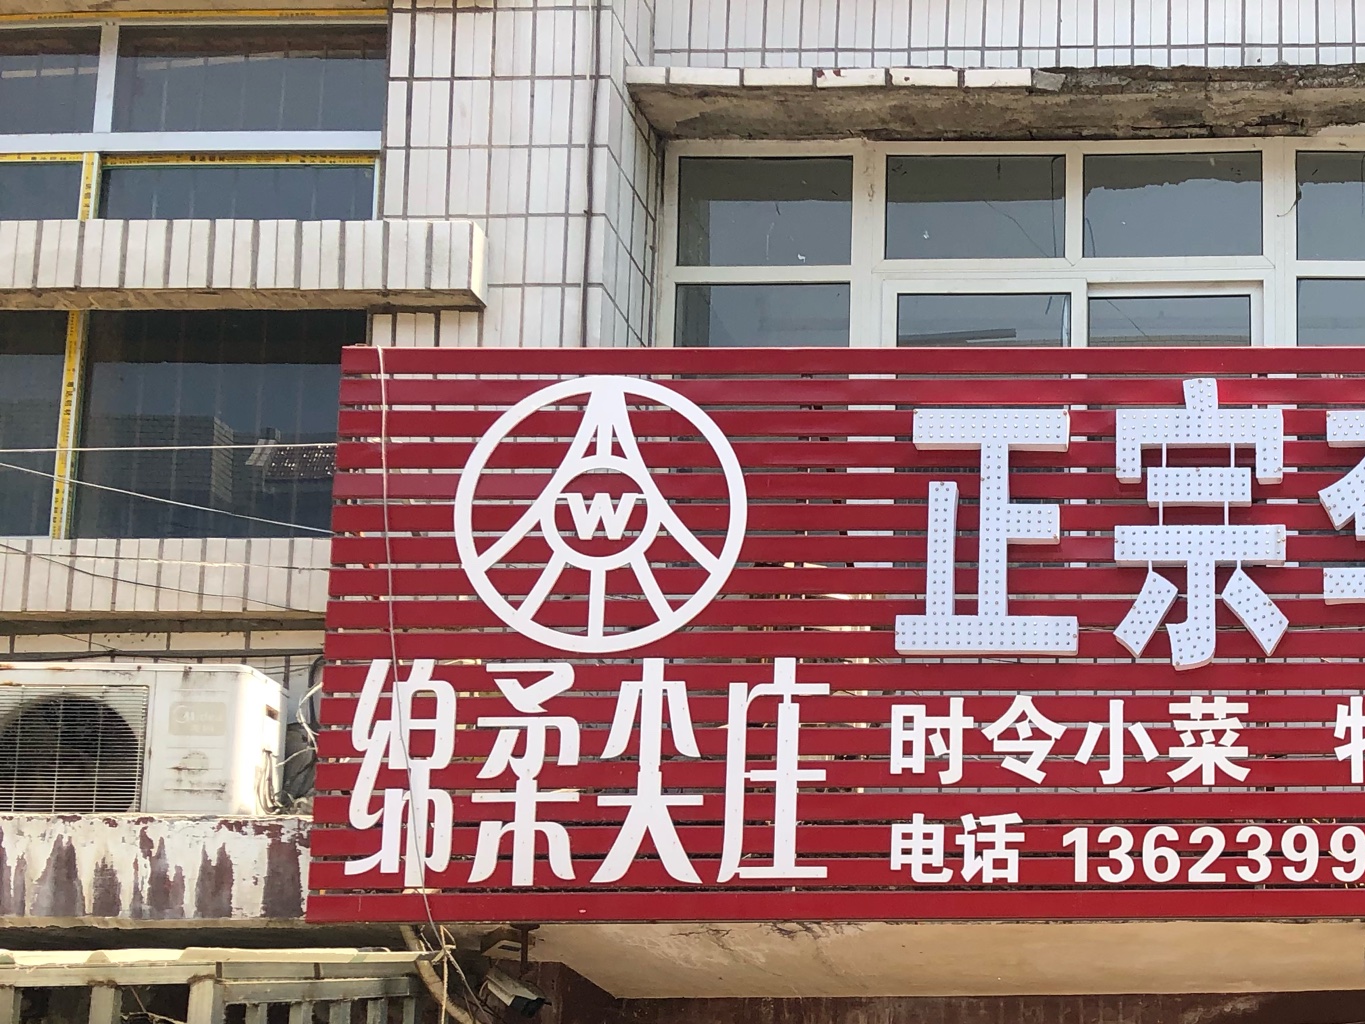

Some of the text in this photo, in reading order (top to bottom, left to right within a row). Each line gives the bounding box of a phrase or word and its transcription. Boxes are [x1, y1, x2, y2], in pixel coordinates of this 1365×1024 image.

[344, 656, 831, 888] 绵柔尖庄
[890, 693, 1252, 786] 时令小菜
[889, 812, 1026, 885] 电话
